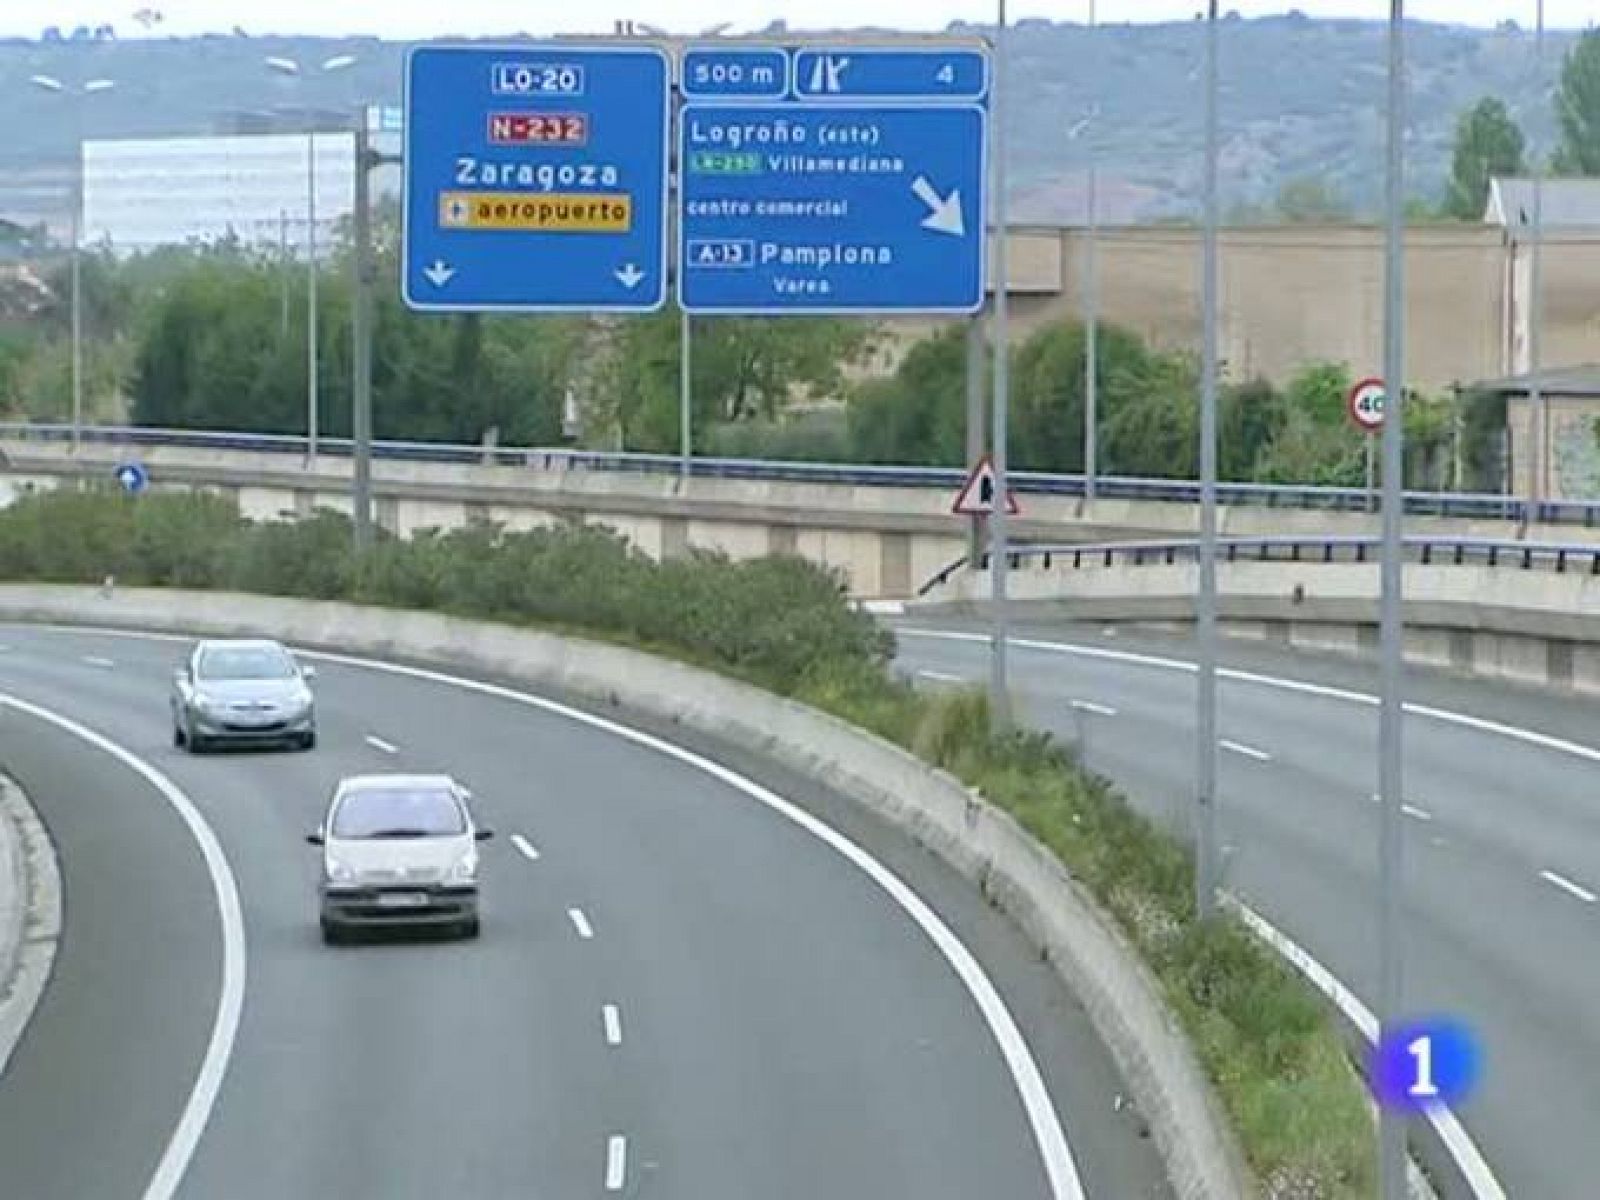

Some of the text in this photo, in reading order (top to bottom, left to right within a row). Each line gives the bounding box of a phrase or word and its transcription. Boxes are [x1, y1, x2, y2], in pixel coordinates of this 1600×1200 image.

[500, 70, 576, 90] LO-20
[695, 65, 774, 83] 500 m
[936, 66, 953, 83] 4
[493, 118, 584, 140] N-232
[691, 120, 806, 148] Logroño
[456, 159, 618, 190] Zaragoza
[477, 202, 626, 223] aeropuerto
[687, 200, 848, 216] centro comercial
[761, 244, 892, 271] Pamplona
